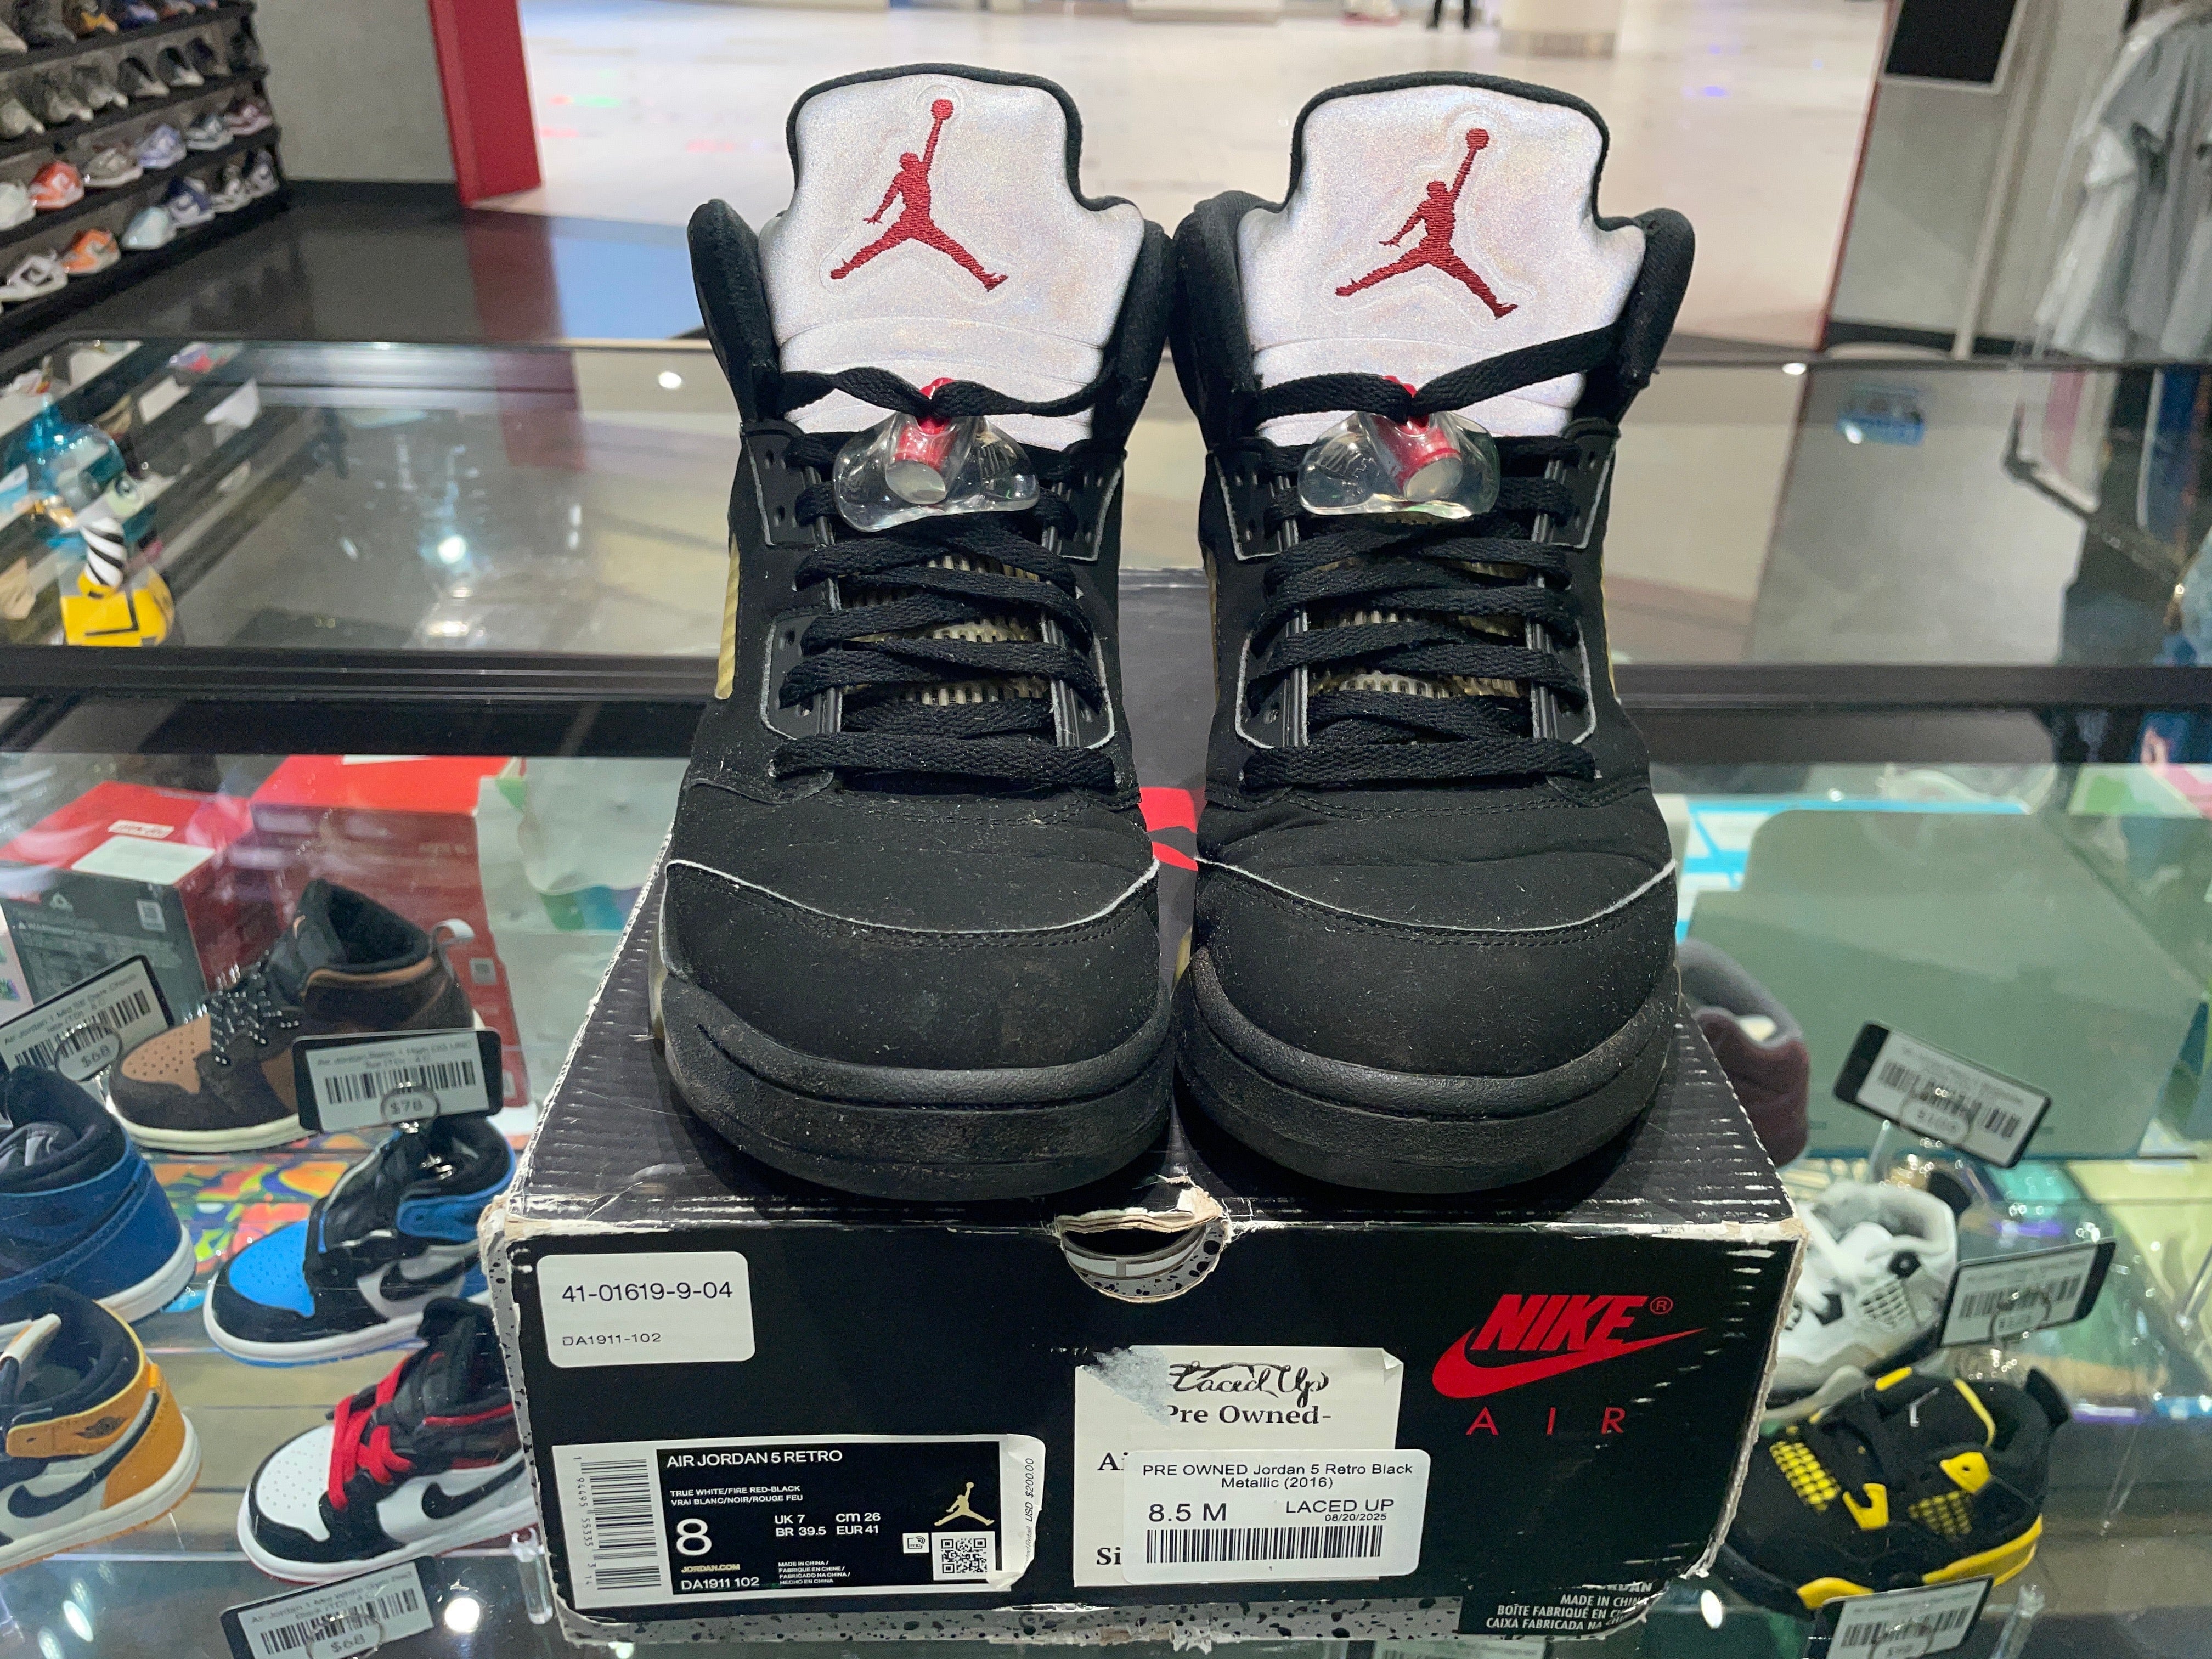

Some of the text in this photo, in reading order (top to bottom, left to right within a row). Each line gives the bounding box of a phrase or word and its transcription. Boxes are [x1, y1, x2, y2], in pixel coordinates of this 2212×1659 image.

[562, 1281, 733, 1302] 41-01619-9-04
[1470, 1294, 1649, 1351] NIKE
[562, 1333, 662, 1346] DA1911-102
[667, 1449, 843, 1468] AIR JORDAN 5 RETRO
[1143, 1463, 1413, 1476] PRE OWNED Jordan 5 Retro Black
[1025, 1458, 1035, 1498] $200.00
[1221, 1476, 1334, 1489] Metallic (2016)
[670, 1485, 801, 1497] TRUE WHITE/FIRE RED-BLACK
[671, 1493, 803, 1506] VRAI BLANC/NOIR/ROUGE FEU
[1286, 1498, 1395, 1514] LACED UP
[835, 1512, 881, 1523] cm 26
[1025, 1502, 1034, 1522] USD
[1148, 1503, 1227, 1522] 8.5 M
[1324, 1513, 1387, 1522] 08/20/2025
[775, 1514, 805, 1525] UK 7
[775, 1526, 827, 1537] BR 39.5
[836, 1525, 879, 1535] EUR 41
[676, 1518, 712, 1556] 8
[681, 1564, 741, 1573] JORDAN.COM
[681, 1577, 760, 1590] DA1911 102
[1560, 1594, 1644, 1607] MADE IN CHIN
[1498, 1602, 1530, 1616] BOÎTE
[1592, 1609, 1607, 1620] EN
[1486, 1617, 1519, 1628] CAIXA
[1522, 1618, 1584, 1630] FABRICADA
[330, 1633, 366, 1653] $68
